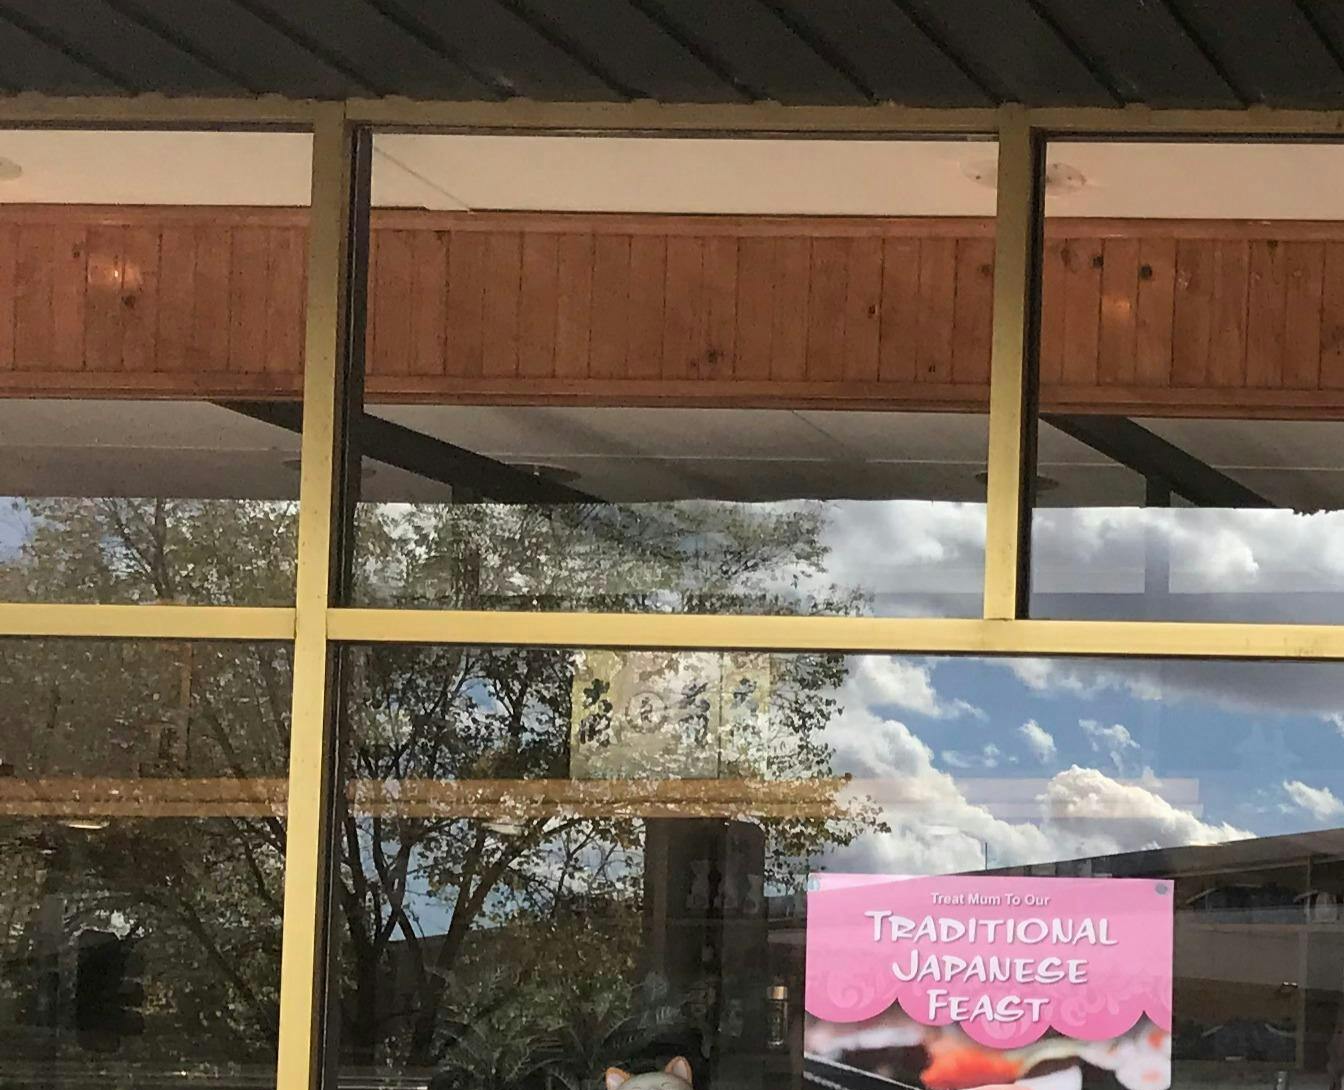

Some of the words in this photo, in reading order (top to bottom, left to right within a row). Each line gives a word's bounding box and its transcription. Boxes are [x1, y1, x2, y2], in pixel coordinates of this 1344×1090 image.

[930, 892, 964, 906] Treat
[968, 893, 1000, 906] Mum
[1005, 893, 1021, 906] To
[1025, 894, 1050, 906] Our
[864, 910, 1118, 946] TRADITIONAL
[892, 949, 1088, 984] JAPANESE
[926, 988, 1050, 1023] FEAST
